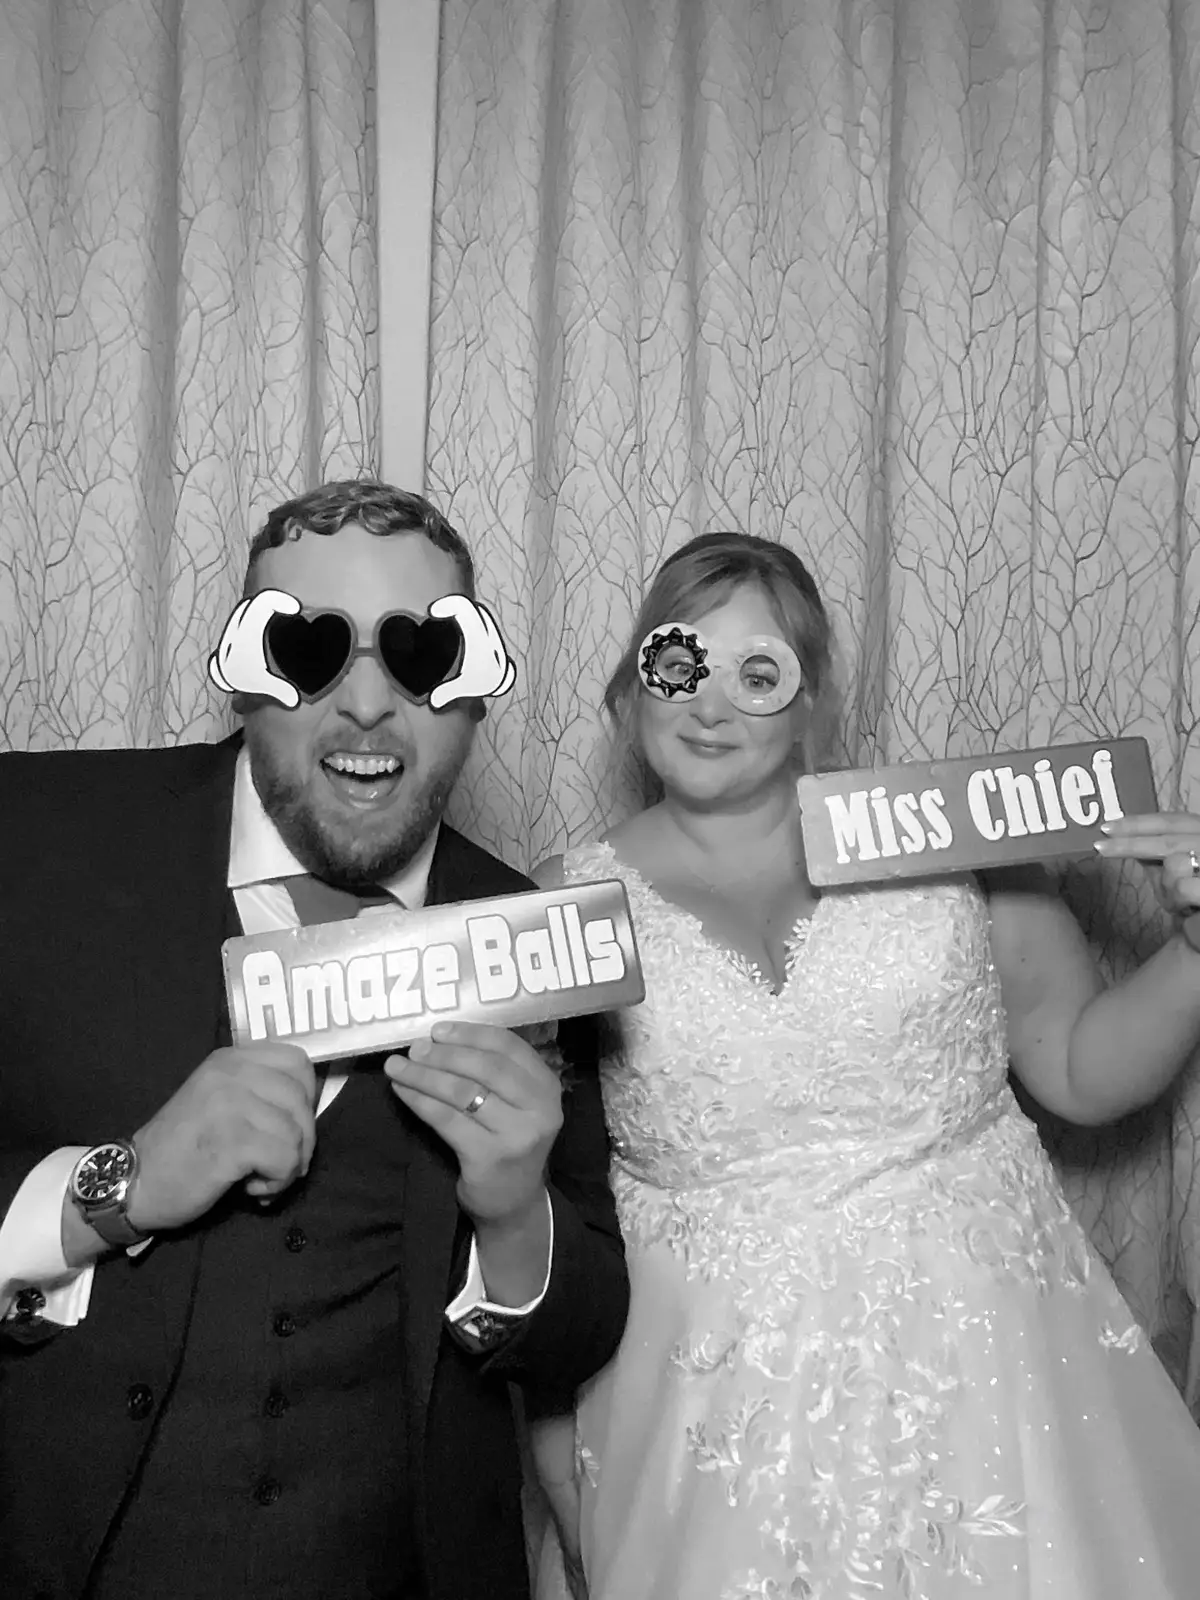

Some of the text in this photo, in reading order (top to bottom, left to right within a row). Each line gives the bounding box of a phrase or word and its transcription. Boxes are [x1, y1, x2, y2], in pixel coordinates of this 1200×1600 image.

[825, 749, 1124, 864] Miss Chief
[242, 903, 626, 1040] Amaze Balls
